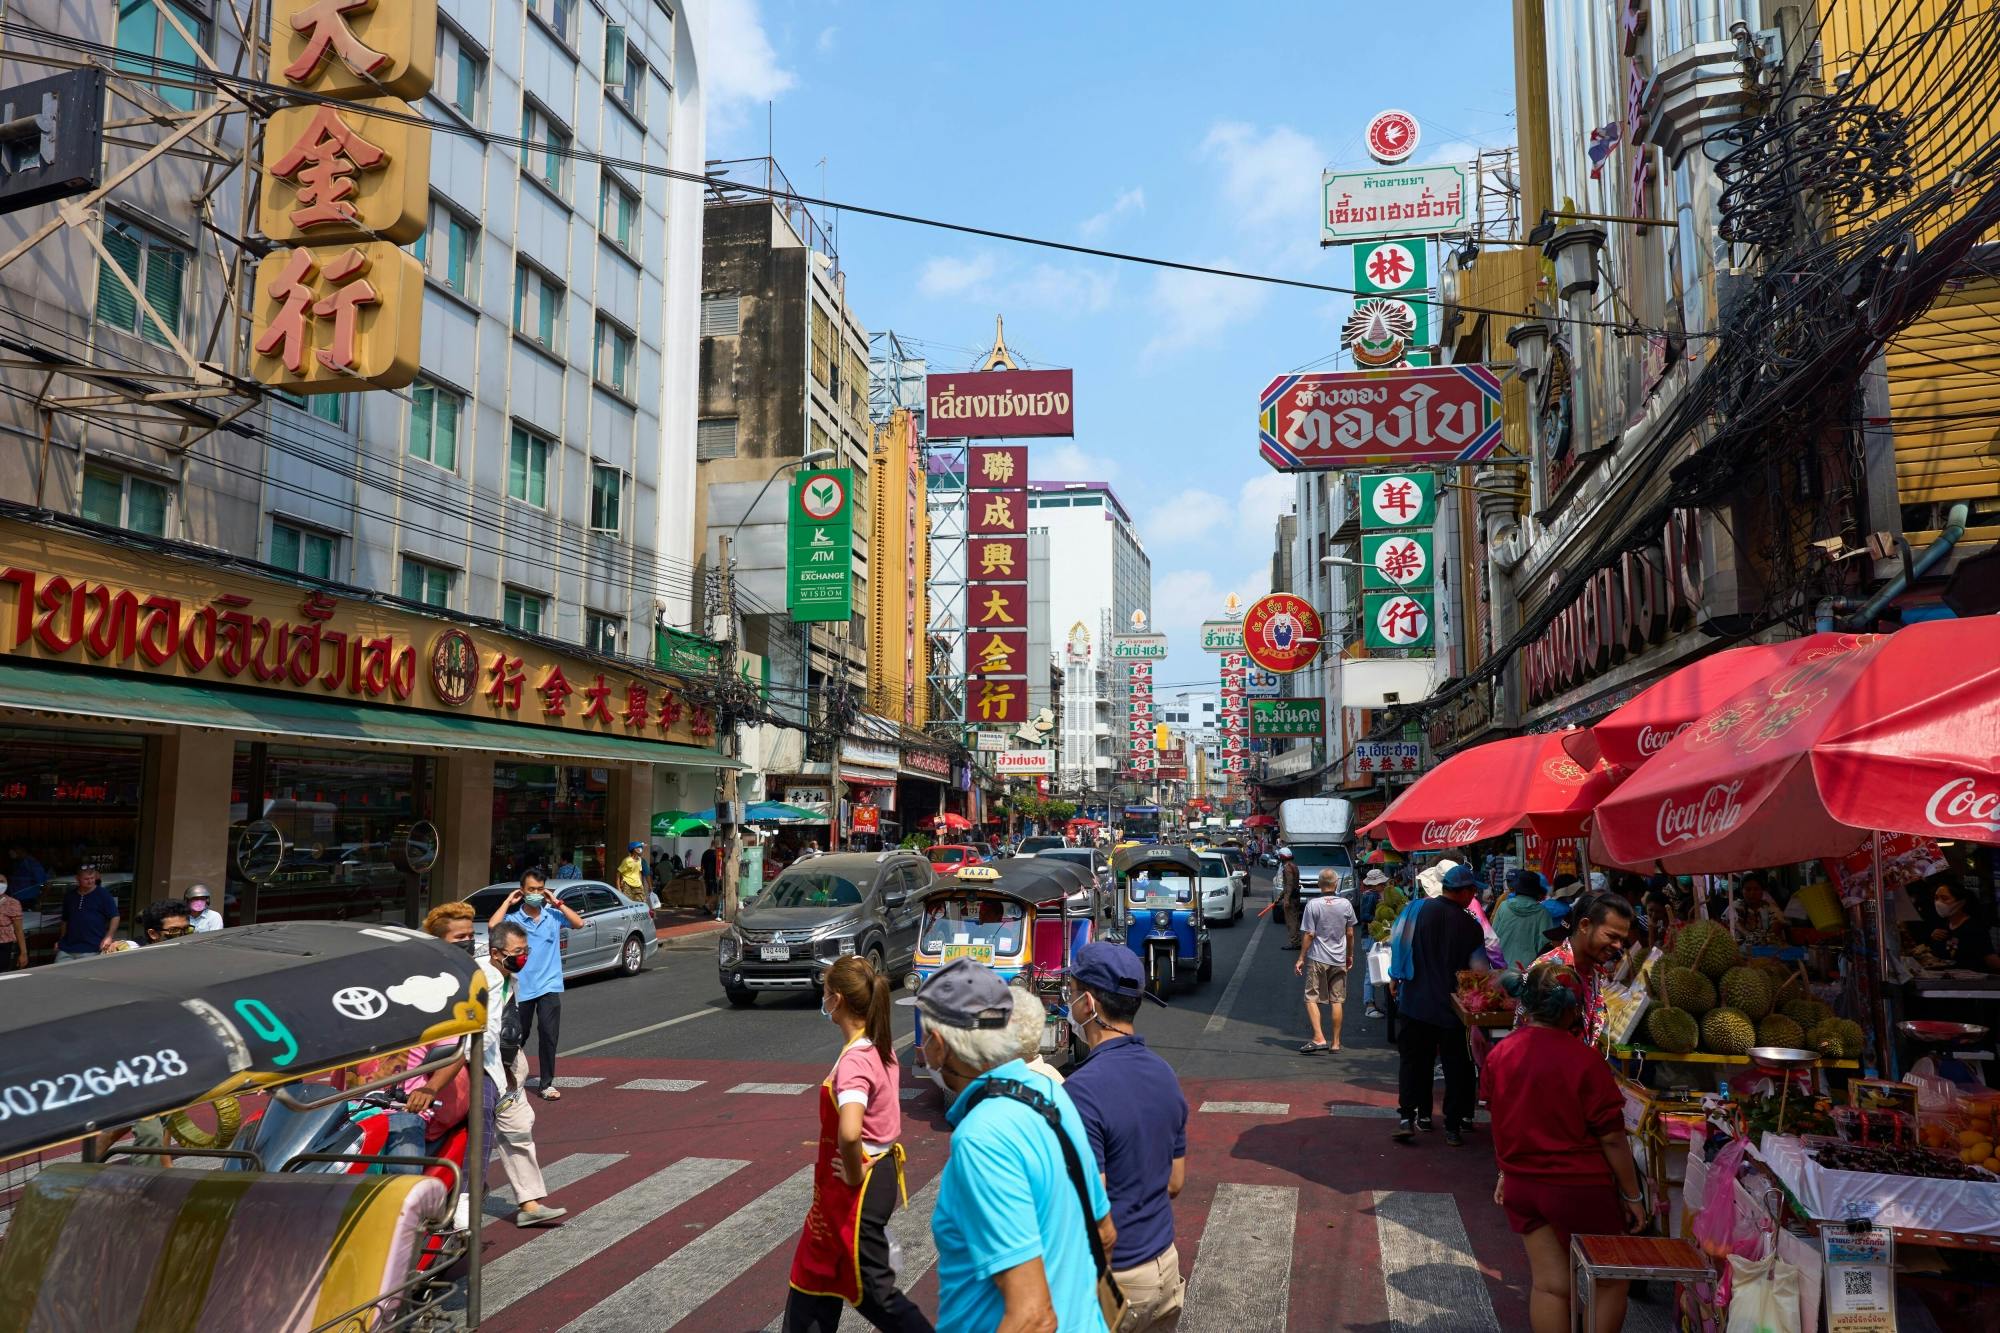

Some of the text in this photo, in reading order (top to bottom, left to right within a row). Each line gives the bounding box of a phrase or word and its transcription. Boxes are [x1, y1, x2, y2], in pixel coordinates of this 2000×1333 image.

[1363, 177, 1425, 189] ห้างขายยา
[931, 383, 1070, 419] เลี่ยงเซ่งเฮง
[1295, 381, 1388, 407] ห้างทอง
[1284, 383, 1477, 450] ทองใบ
[811, 551, 834, 561] ATM
[800, 572, 845, 581] EXCHANGE
[800, 590, 842, 598] WISDOM
[1248, 672, 1277, 686] ttb
[1656, 779, 1744, 847] Coca-Cola
[1421, 817, 1485, 845] Coca-Cola
[963, 868, 989, 876] TAXI
[234, 998, 299, 1066] 9
